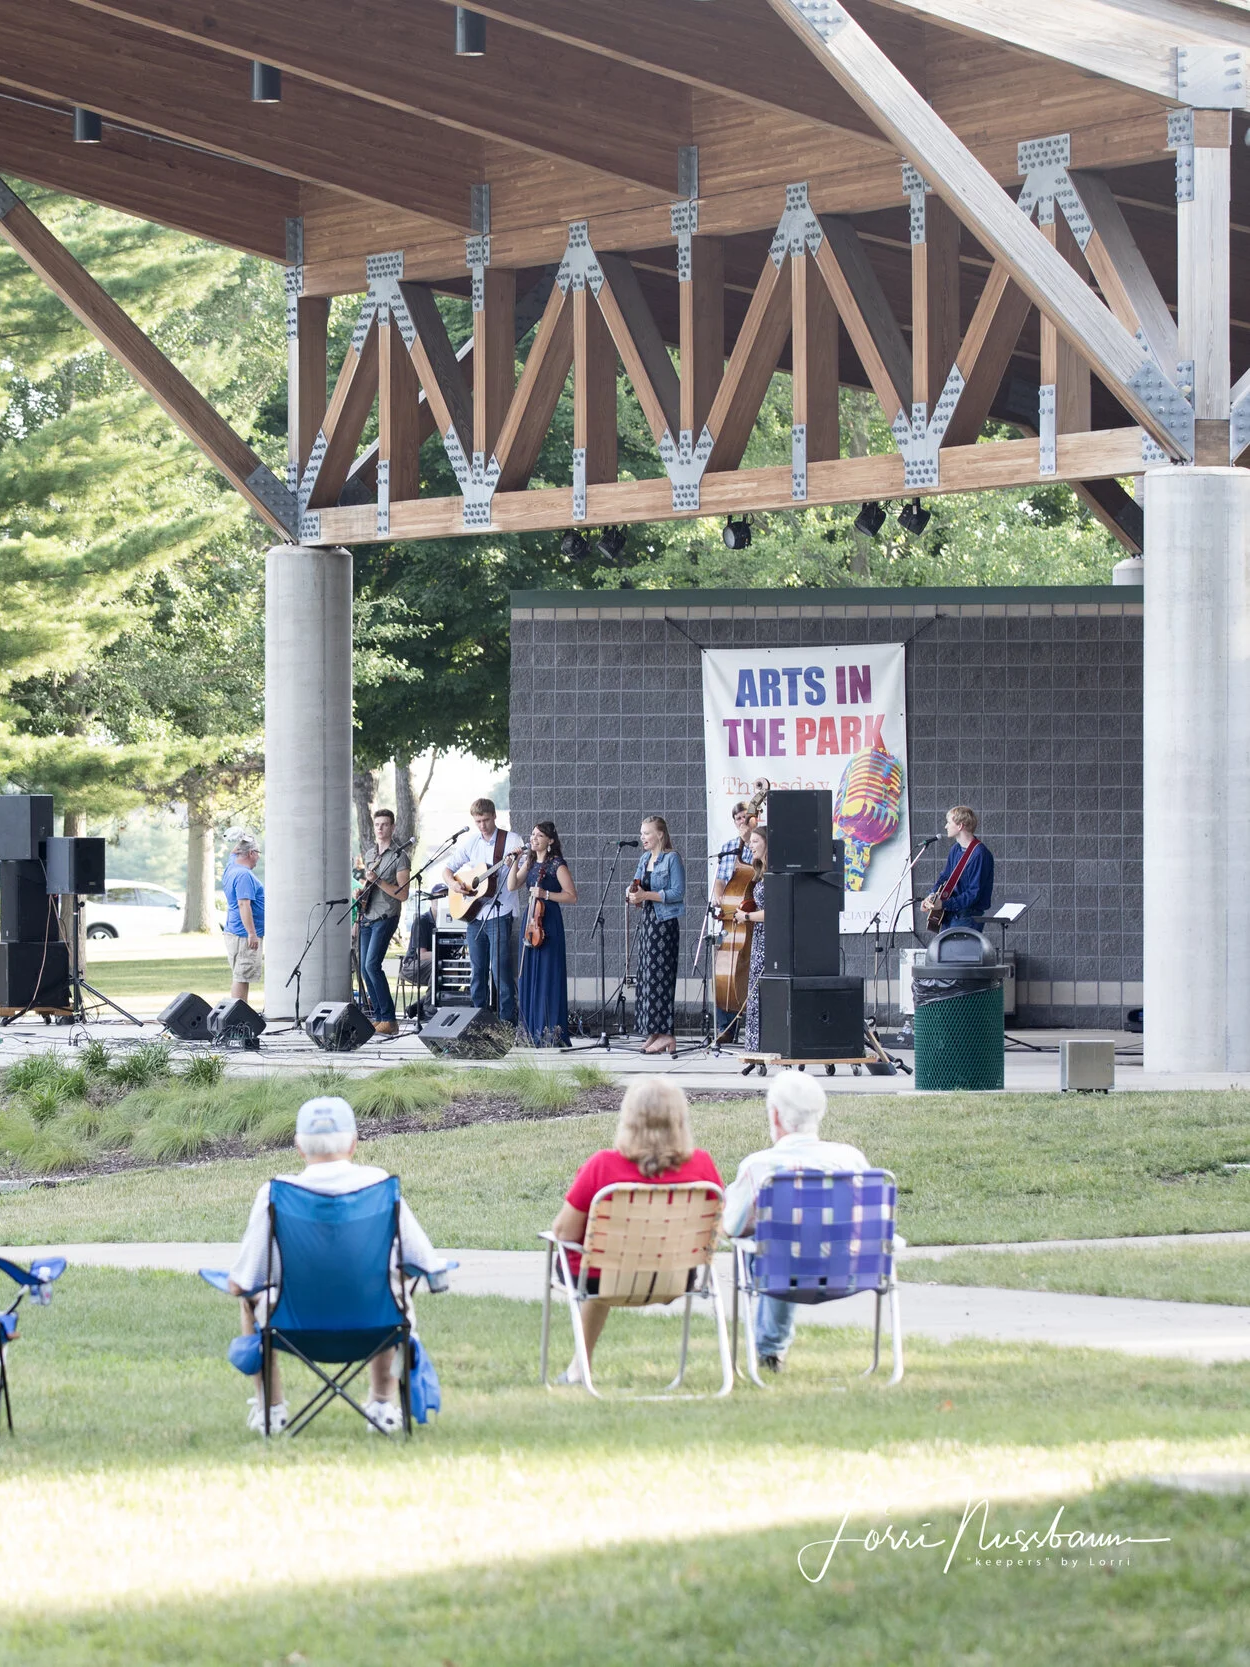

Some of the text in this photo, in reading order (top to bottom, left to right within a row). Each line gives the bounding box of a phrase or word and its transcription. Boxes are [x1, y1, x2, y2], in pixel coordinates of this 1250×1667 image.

[735, 665, 872, 707] ARTS IN
[722, 714, 886, 757] THE PARK
